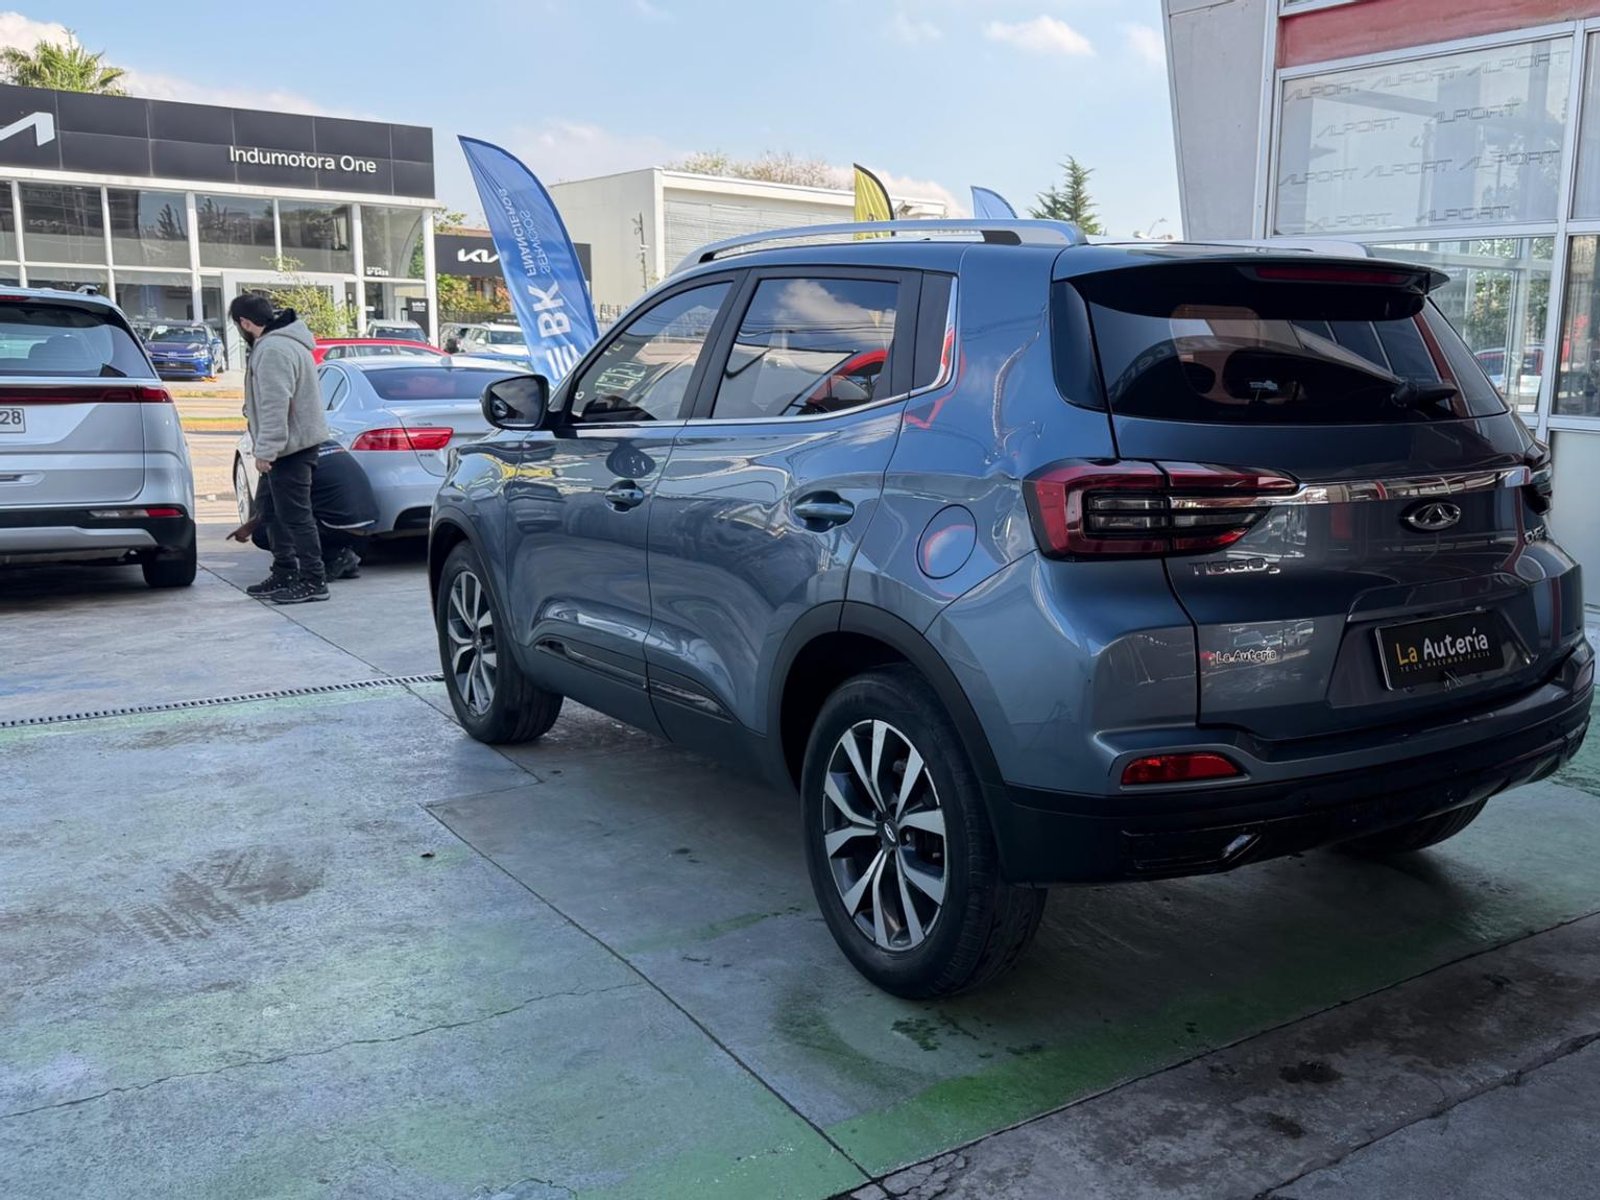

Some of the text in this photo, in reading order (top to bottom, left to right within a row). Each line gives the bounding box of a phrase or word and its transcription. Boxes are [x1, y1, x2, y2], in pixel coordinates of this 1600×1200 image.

[229, 145, 377, 173] Indumotora One
[0, 410, 22, 425] 28
[1395, 626, 1489, 665] La Autería
[1215, 650, 1233, 664] La
